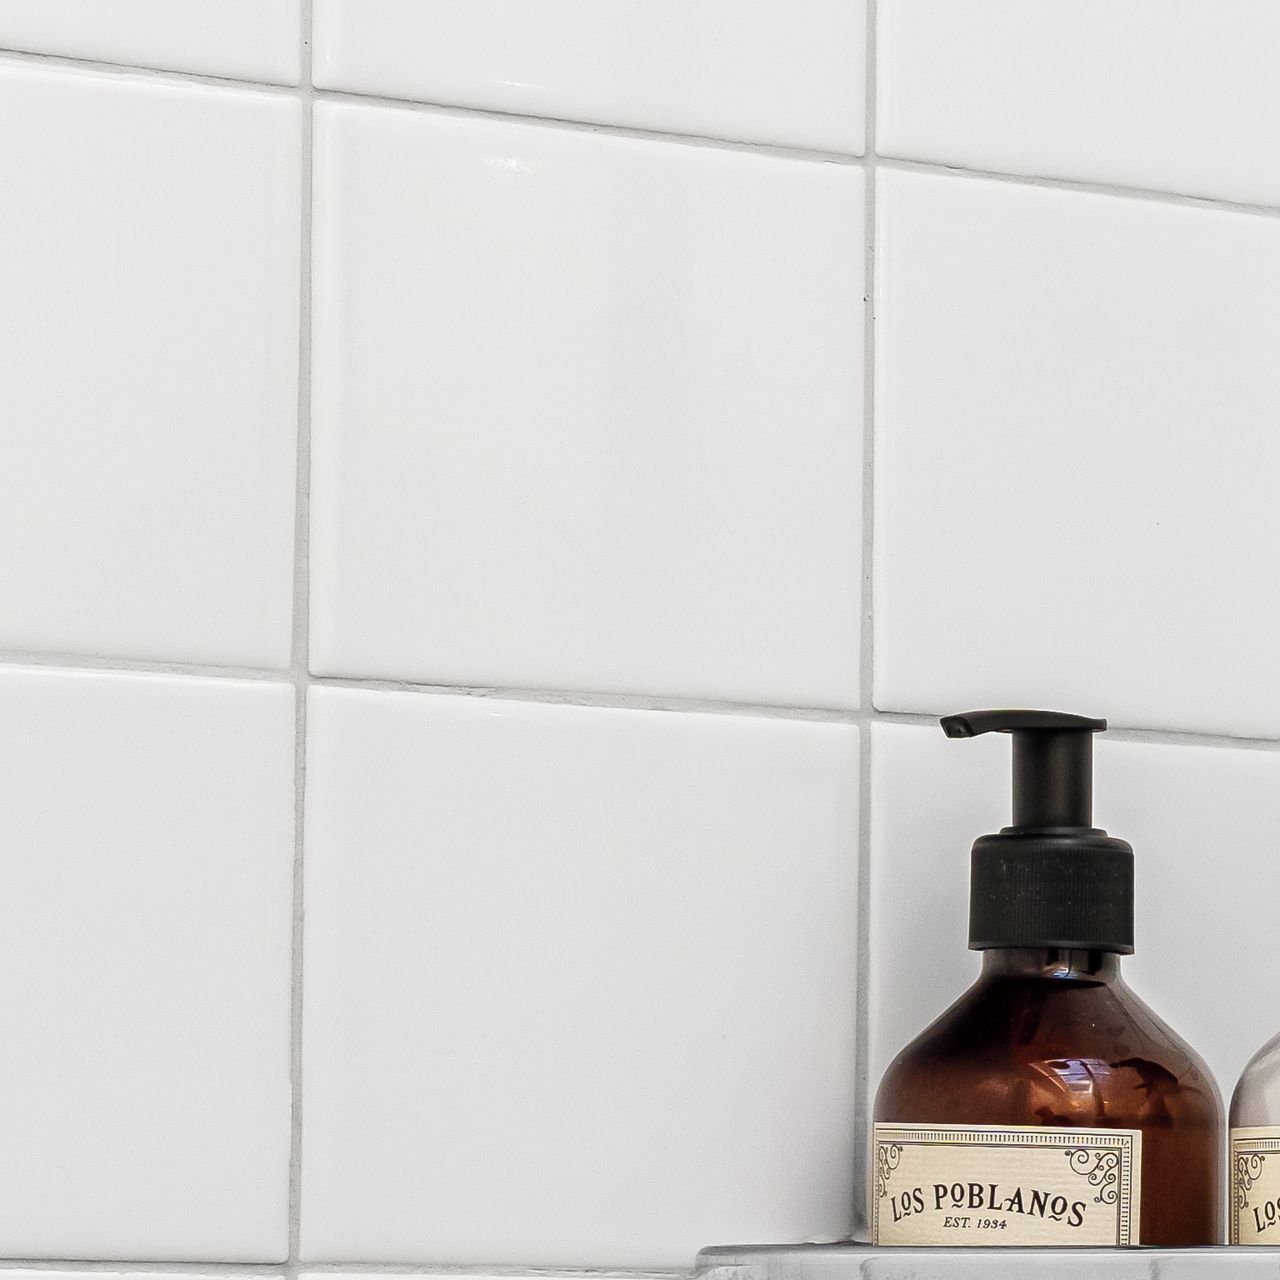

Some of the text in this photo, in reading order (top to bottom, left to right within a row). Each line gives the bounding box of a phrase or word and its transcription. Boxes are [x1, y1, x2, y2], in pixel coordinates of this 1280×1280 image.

[891, 1182, 1087, 1227] LOS POBLANOS
[943, 1216, 1008, 1230] EST. 1934
